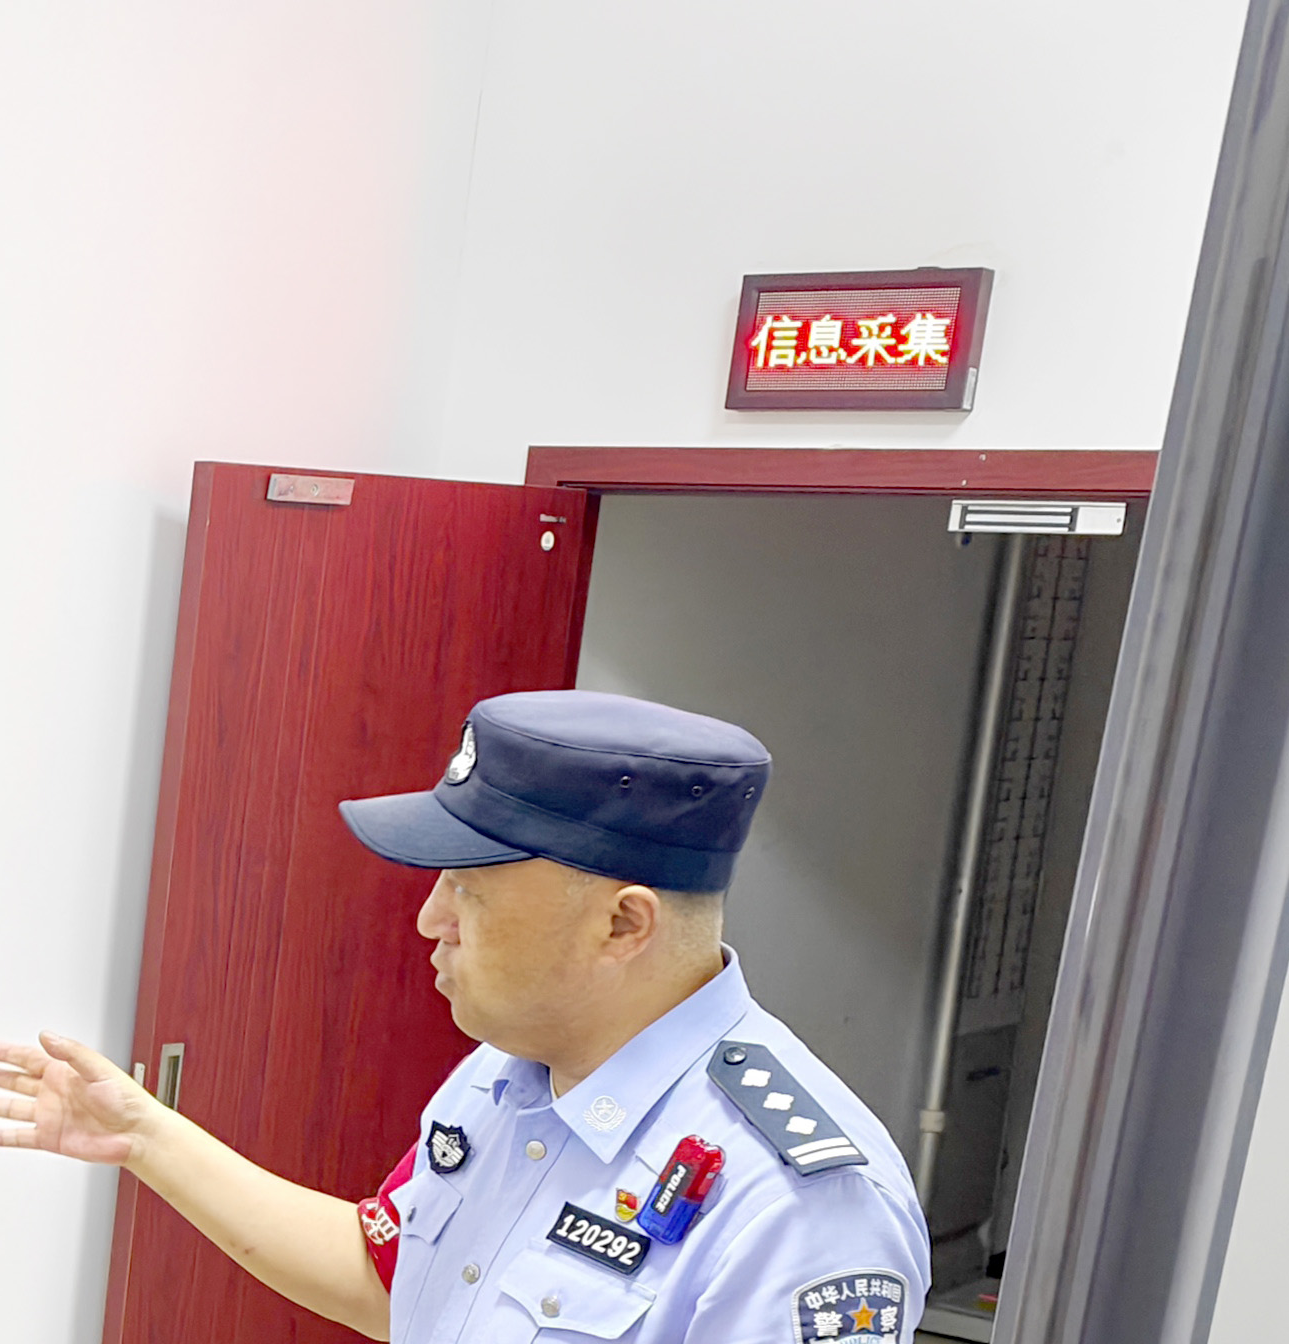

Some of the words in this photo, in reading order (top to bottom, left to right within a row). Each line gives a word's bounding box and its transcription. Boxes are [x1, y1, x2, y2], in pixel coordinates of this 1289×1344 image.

[750, 313, 950, 368] 信息采集
[654, 1164, 687, 1213] POLICE
[556, 1214, 641, 1266] 120292
[805, 1279, 902, 1310] 中华人民共和国
